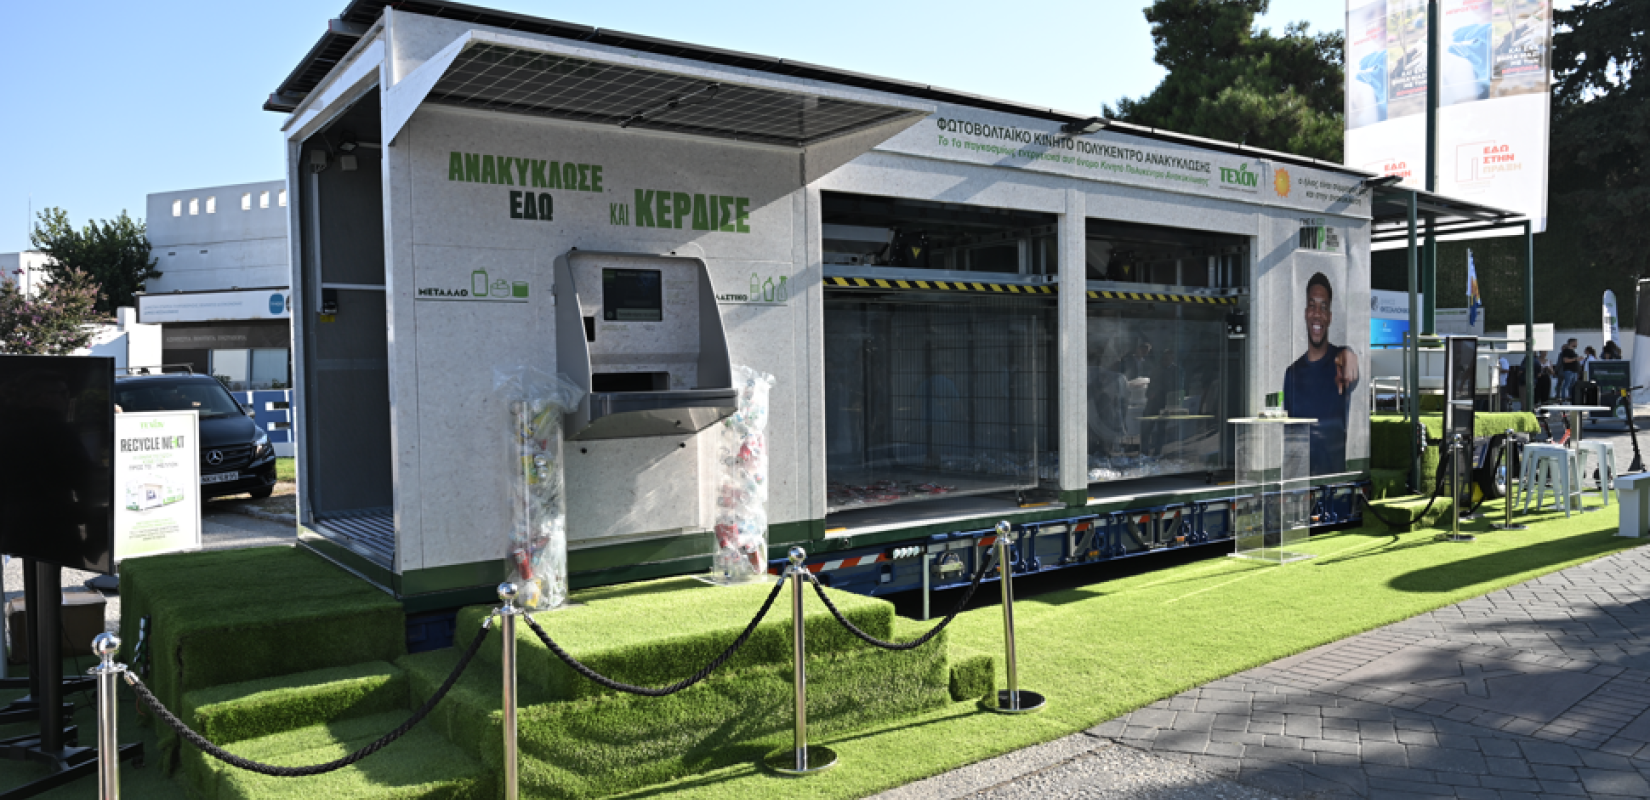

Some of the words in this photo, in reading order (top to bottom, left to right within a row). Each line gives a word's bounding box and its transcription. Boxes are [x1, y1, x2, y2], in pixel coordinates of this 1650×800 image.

[937, 117, 1031, 144] ΦΩΤΟΒΟΛΤΑΪΚΟ
[1033, 132, 1074, 151] ΚΙΝΗΤΟ
[1076, 140, 1143, 163] ΠΟΛΥΚΕΝΤΡΟ
[1144, 152, 1211, 174] ΑΝΑΚΥΚΛΩΣΗΣ
[1483, 153, 1515, 164] ΣΤΗΝ
[449, 152, 603, 192] ΑΝΑΚΥΚΛΩΣΕ
[510, 190, 554, 221] ΕΔΩ
[609, 202, 629, 226] ΚΑΙ
[634, 188, 750, 233] ΚΕΡΔΙΣΕ
[120, 437, 161, 452] RECYCLE
